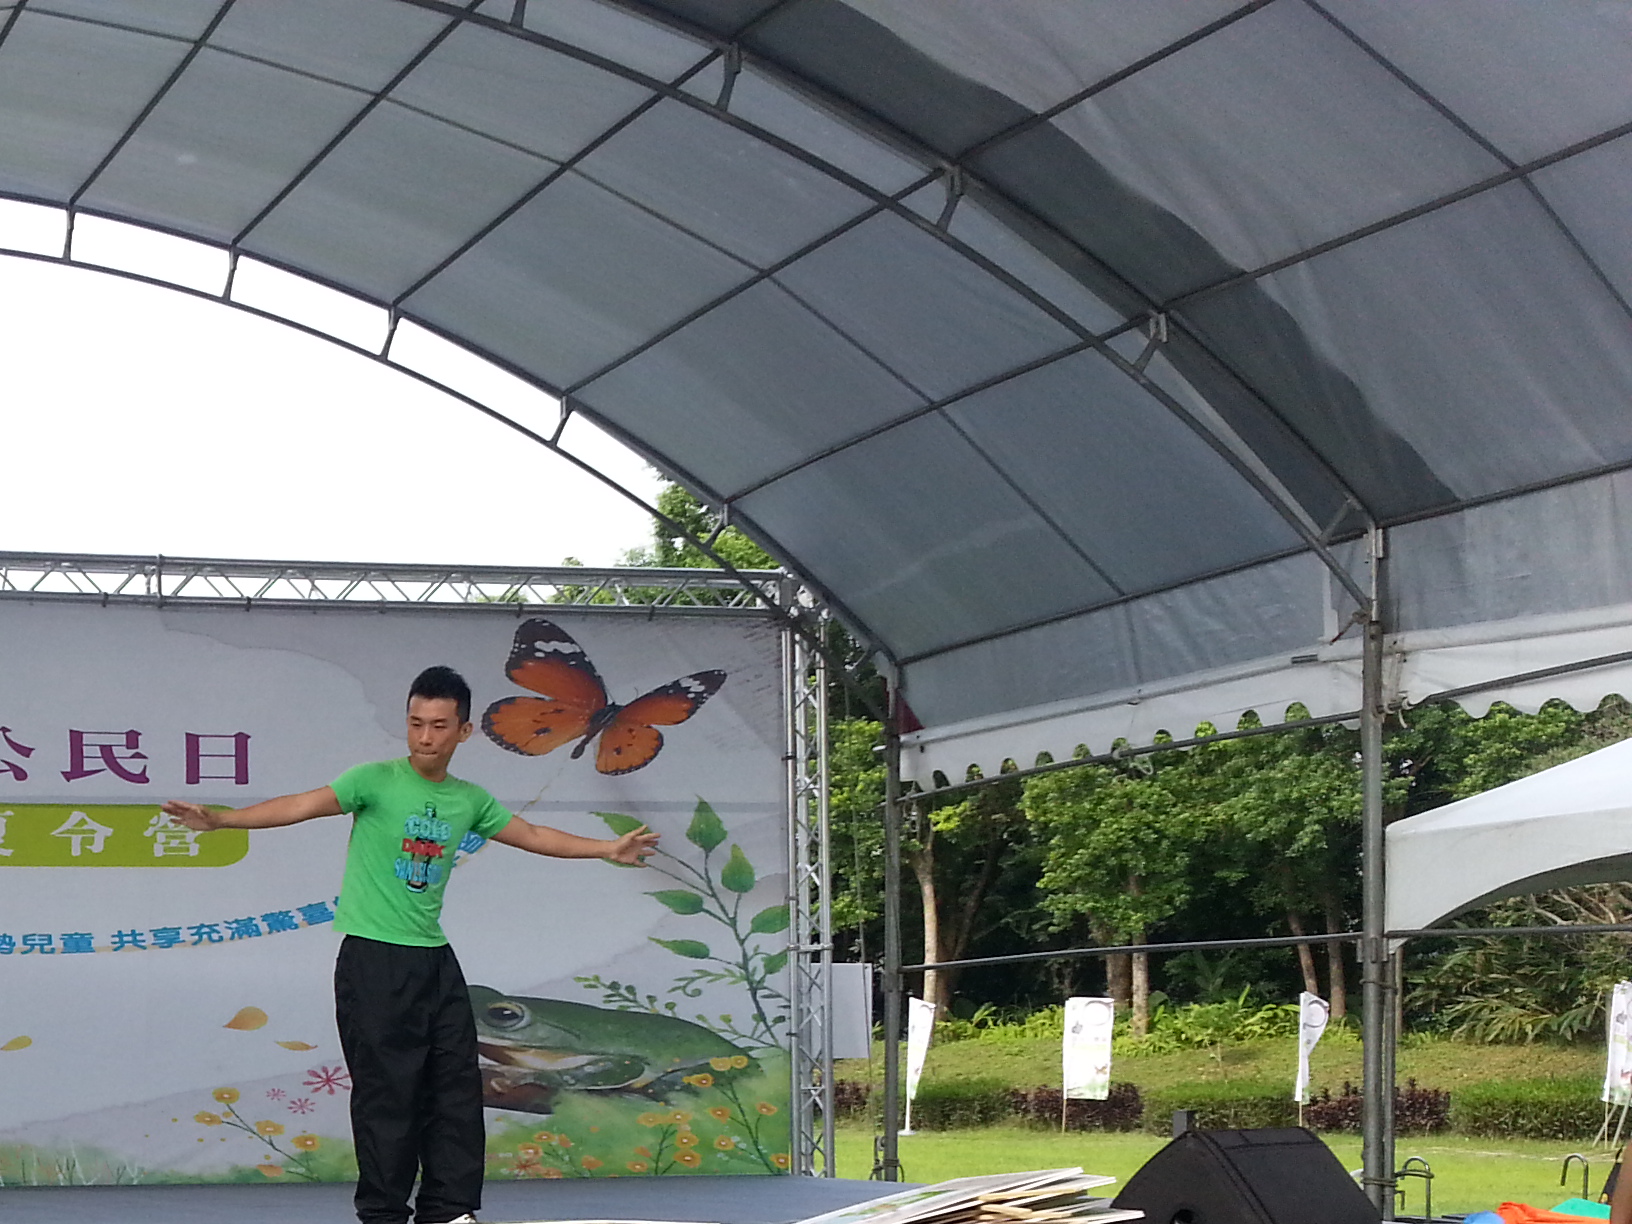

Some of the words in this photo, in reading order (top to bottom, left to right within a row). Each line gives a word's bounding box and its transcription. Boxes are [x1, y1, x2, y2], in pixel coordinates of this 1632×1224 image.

[110, 895, 339, 952] 共享充滿驚喜
